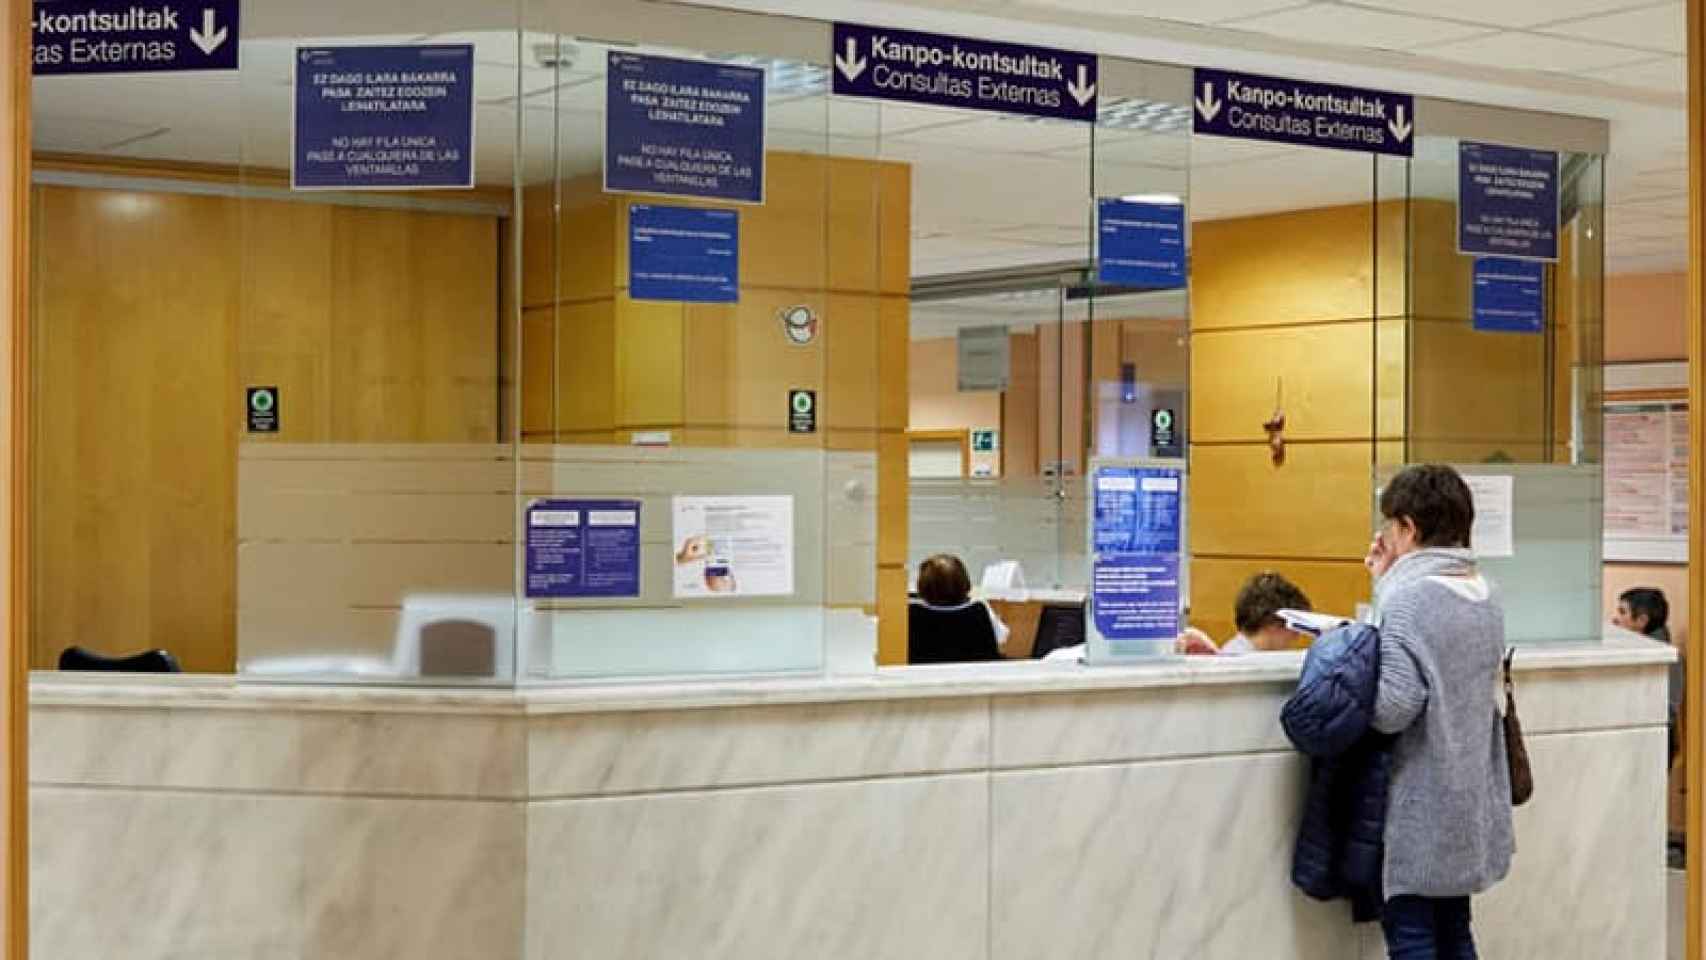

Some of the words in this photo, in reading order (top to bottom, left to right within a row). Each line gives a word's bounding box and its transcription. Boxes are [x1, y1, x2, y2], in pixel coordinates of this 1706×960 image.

[70, 38, 176, 63] Externas
[871, 35, 1063, 80] Kanpo-kontsultak
[872, 64, 972, 98] Consultas
[978, 76, 1061, 107] Externas
[1227, 80, 1386, 119] Kanpo-kontsultak
[1228, 106, 1311, 136] Consultas
[1315, 116, 1384, 143] Externas
